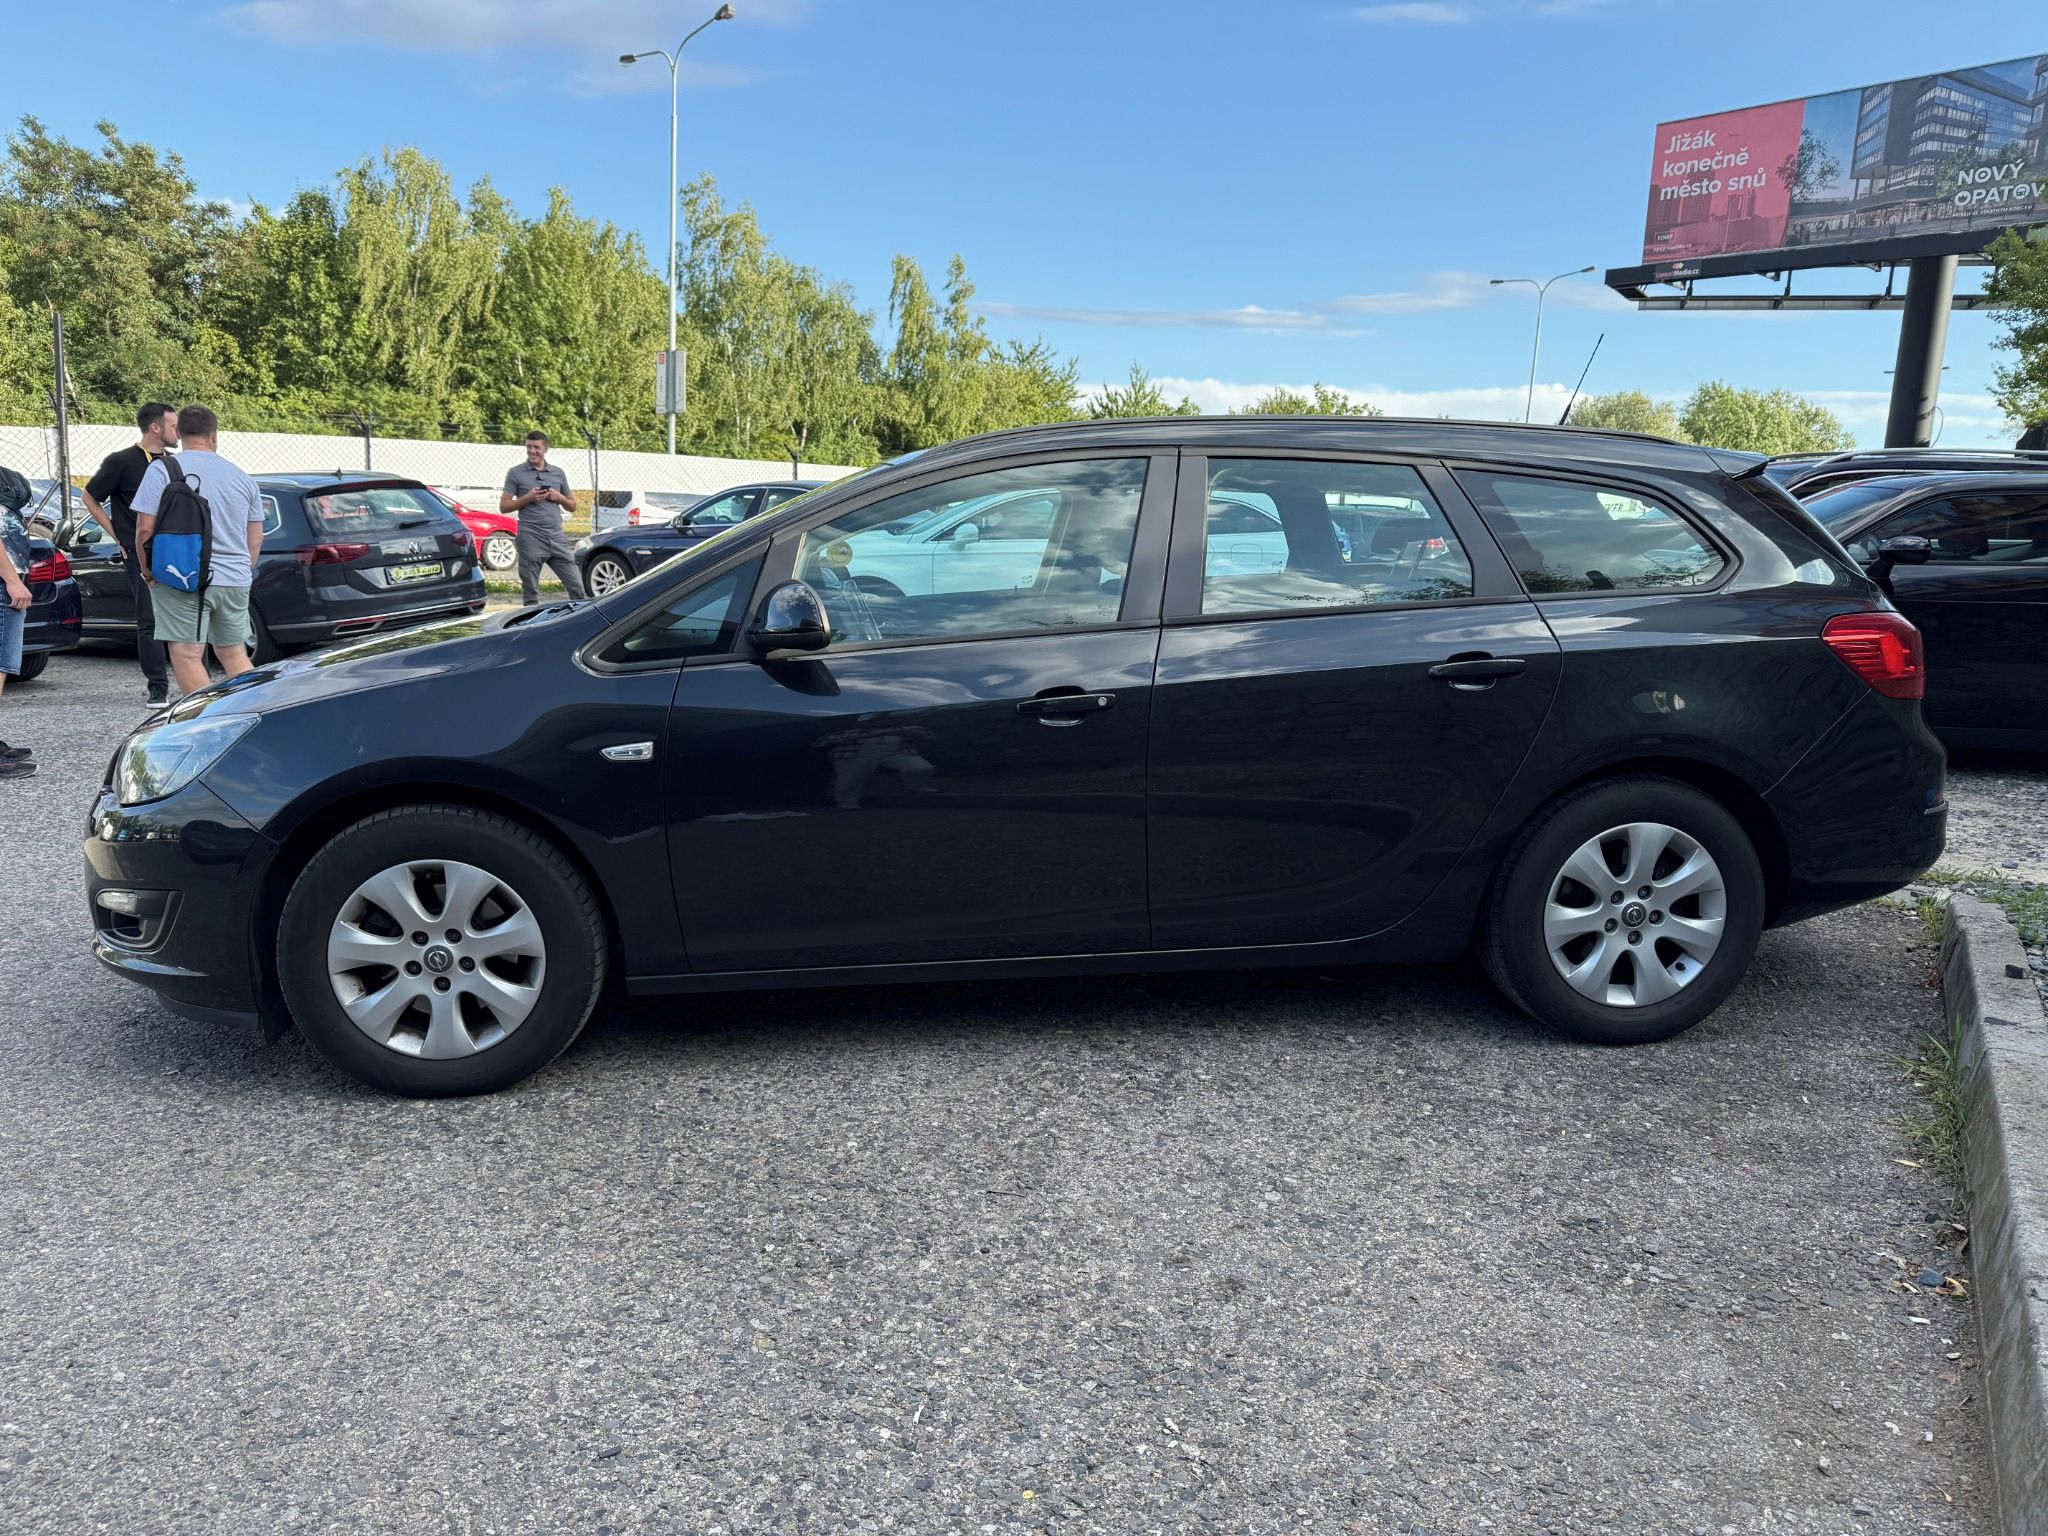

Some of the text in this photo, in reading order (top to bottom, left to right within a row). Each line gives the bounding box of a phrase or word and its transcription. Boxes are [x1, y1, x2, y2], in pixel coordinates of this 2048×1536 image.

[1664, 130, 1716, 154] Jižák
[1662, 146, 1749, 177] konečně
[1958, 159, 2025, 186] NOVÝ
[1660, 168, 1766, 201] město snů
[1955, 183, 2046, 206] OPATOV
